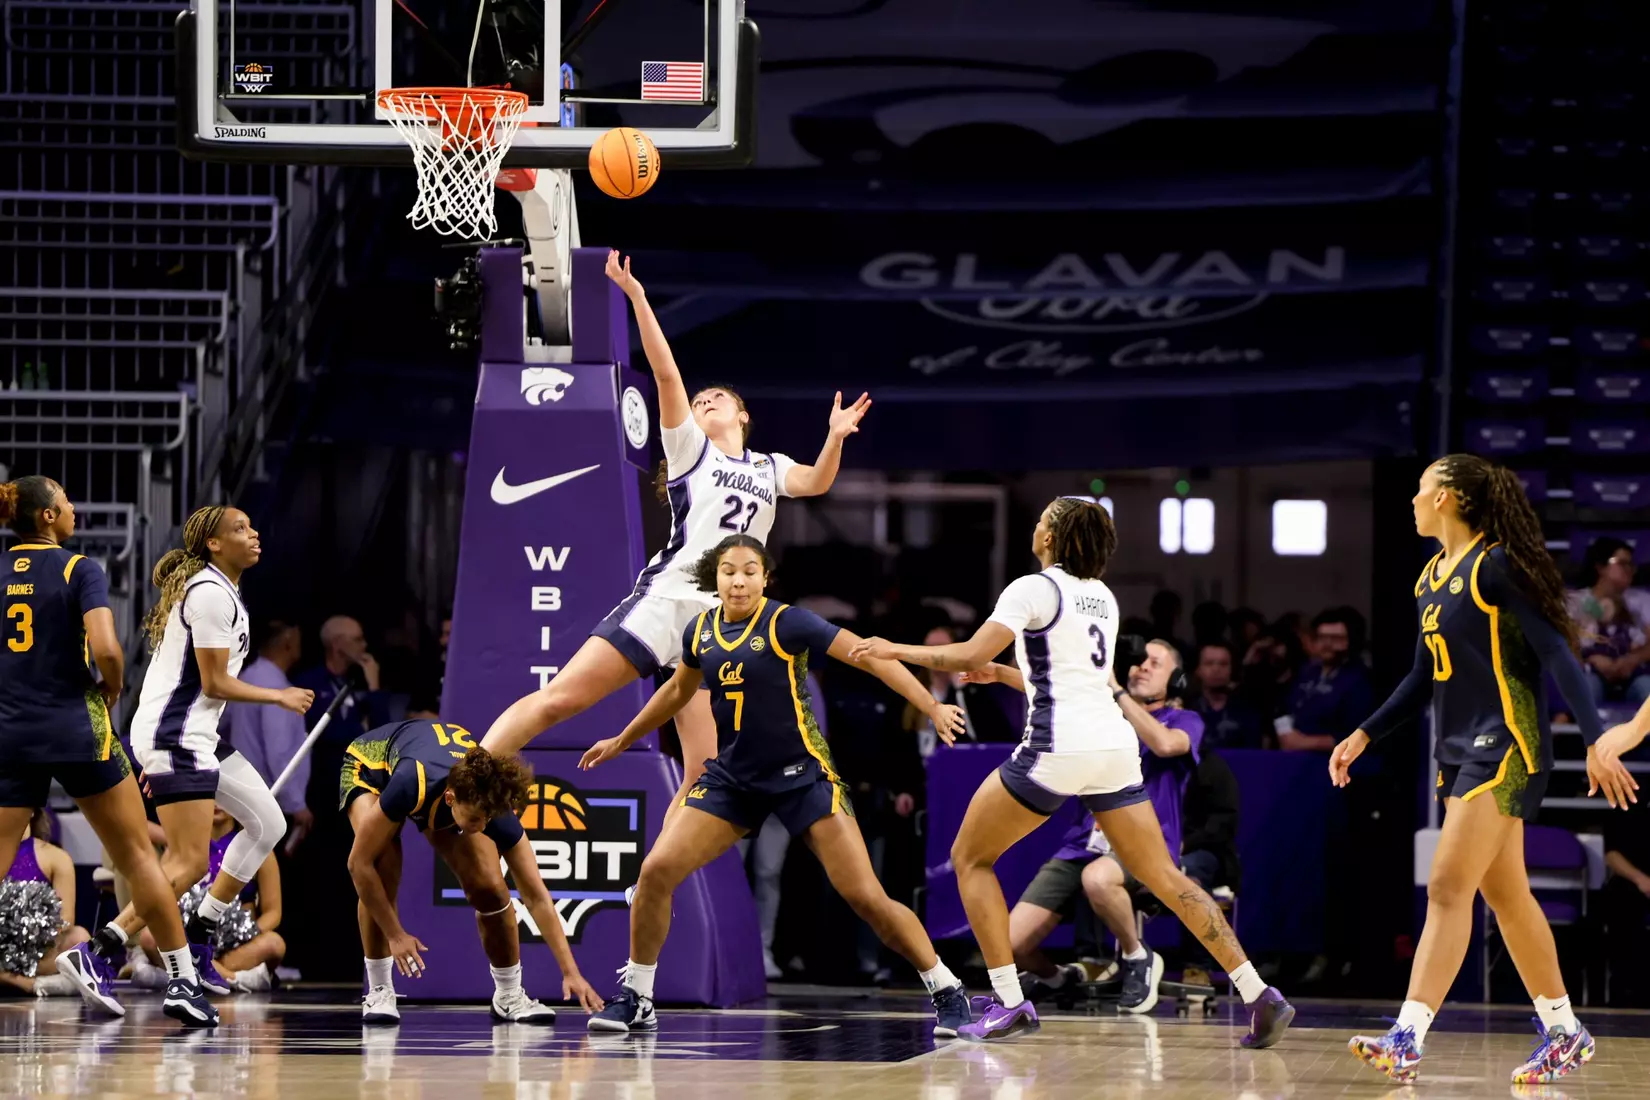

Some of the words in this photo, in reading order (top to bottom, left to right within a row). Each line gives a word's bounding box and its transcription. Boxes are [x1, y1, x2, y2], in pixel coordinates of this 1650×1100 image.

[235, 73, 273, 82] WBIT
[858, 246, 1347, 289] GLAVAN
[712, 469, 773, 505] Wildcats
[719, 495, 758, 533] 23
[7, 584, 35, 596] BARNES
[6, 603, 34, 653] 3
[1421, 603, 1442, 633] Cal
[1088, 623, 1107, 669] 3
[718, 660, 744, 687] Cal
[725, 691, 744, 732] 7
[431, 723, 478, 749] 21
[500, 840, 638, 881] BIT
